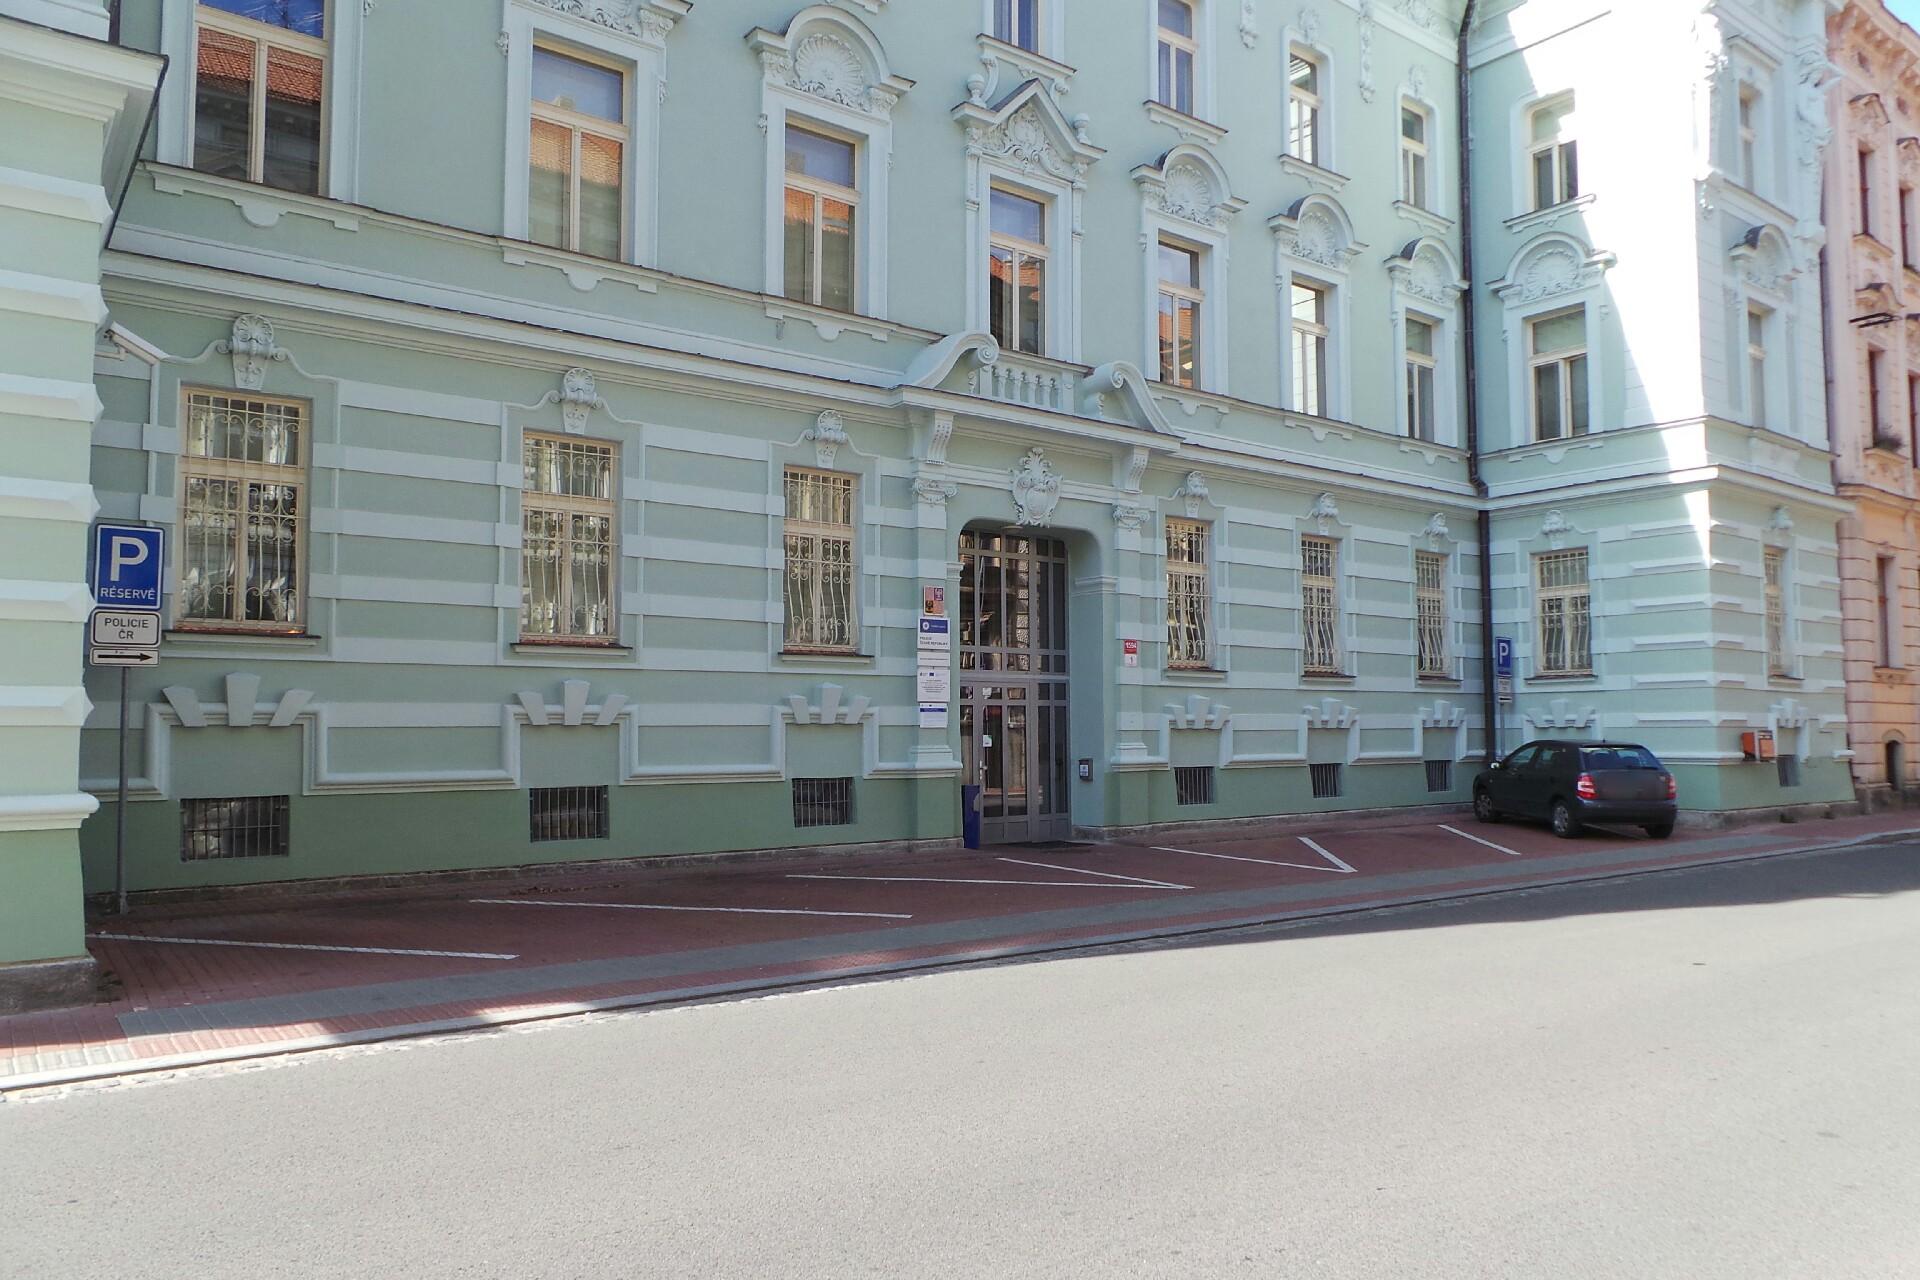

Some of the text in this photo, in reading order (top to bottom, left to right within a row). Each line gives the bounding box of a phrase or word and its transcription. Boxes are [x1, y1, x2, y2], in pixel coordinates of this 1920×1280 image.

[110, 536, 149, 581] P
[100, 585, 156, 600] RÉSERVÉ
[104, 617, 149, 629] POLICIE
[118, 629, 134, 640] ČR
[1499, 642, 1509, 665] P
